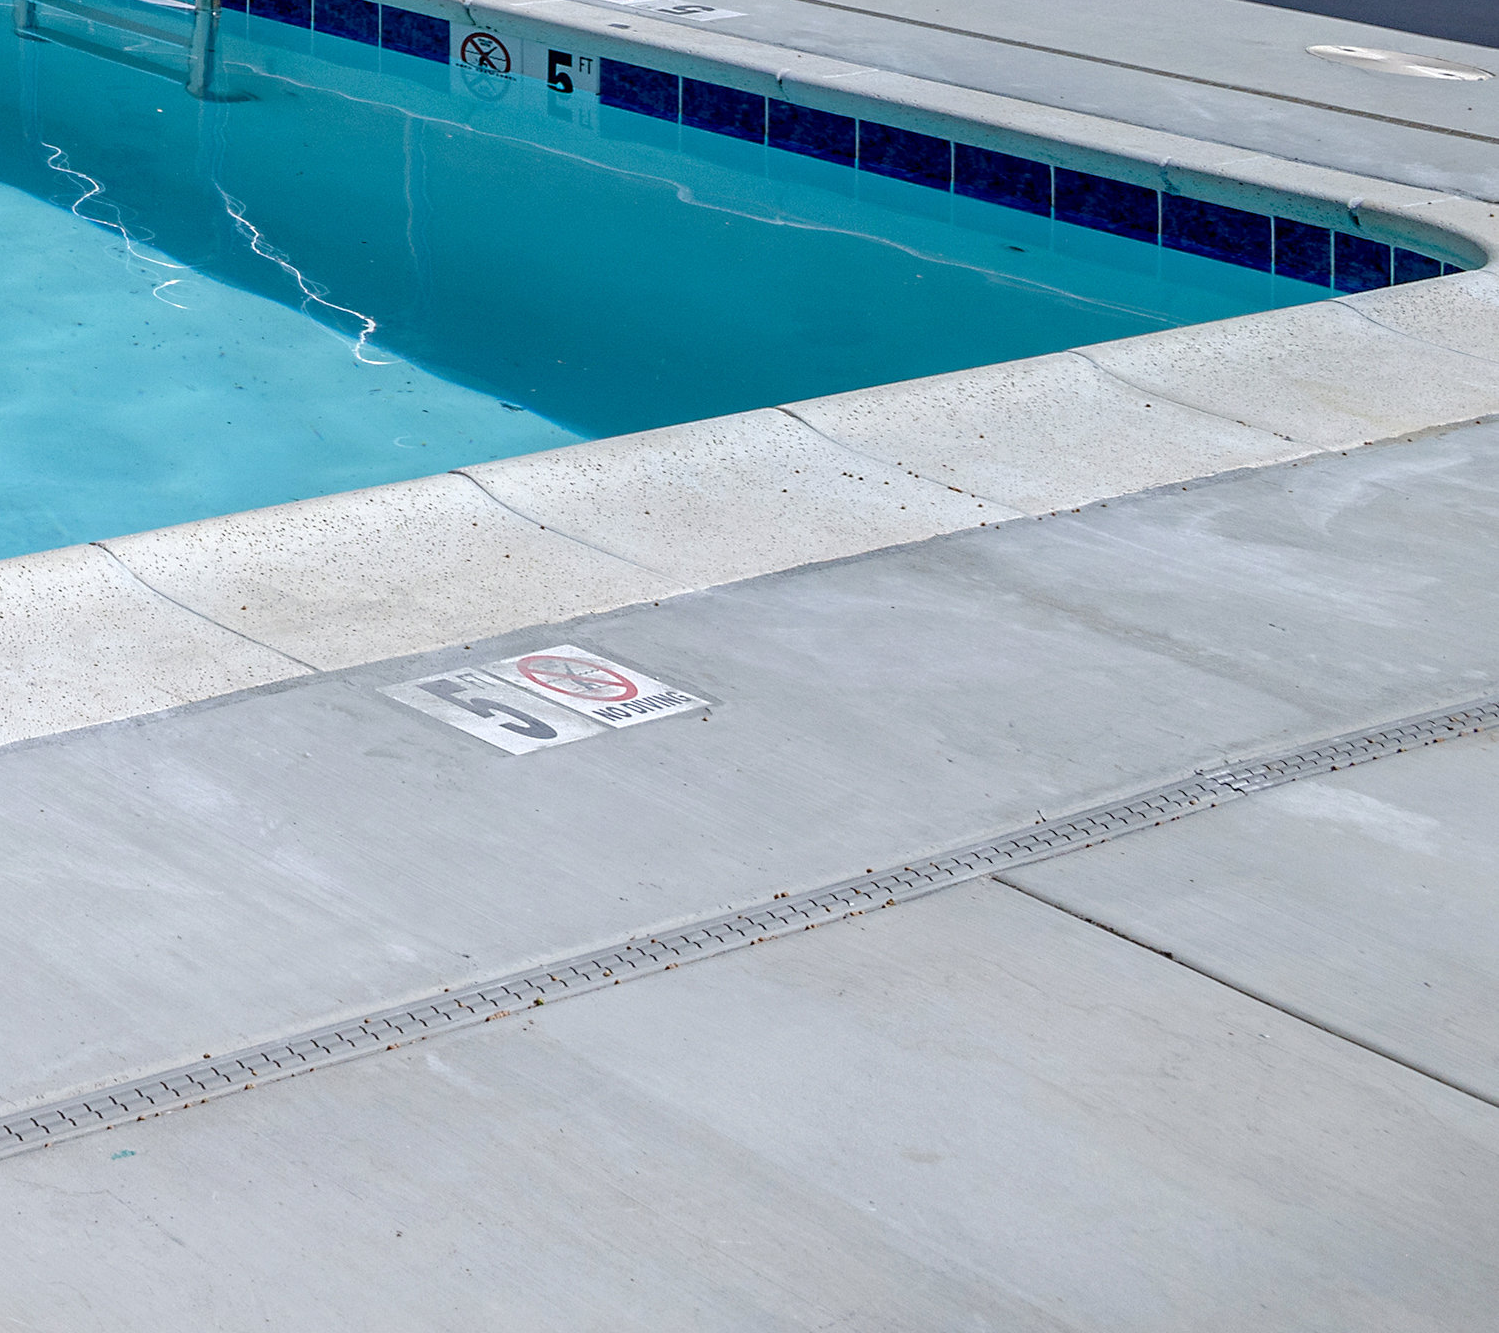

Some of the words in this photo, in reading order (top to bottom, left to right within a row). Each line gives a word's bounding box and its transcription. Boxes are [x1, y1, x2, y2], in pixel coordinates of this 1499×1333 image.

[547, 48, 574, 94] 5
[578, 56, 594, 75] FT
[414, 678, 558, 740] 5
[592, 705, 632, 722] NO
[620, 690, 692, 715] DIVING
